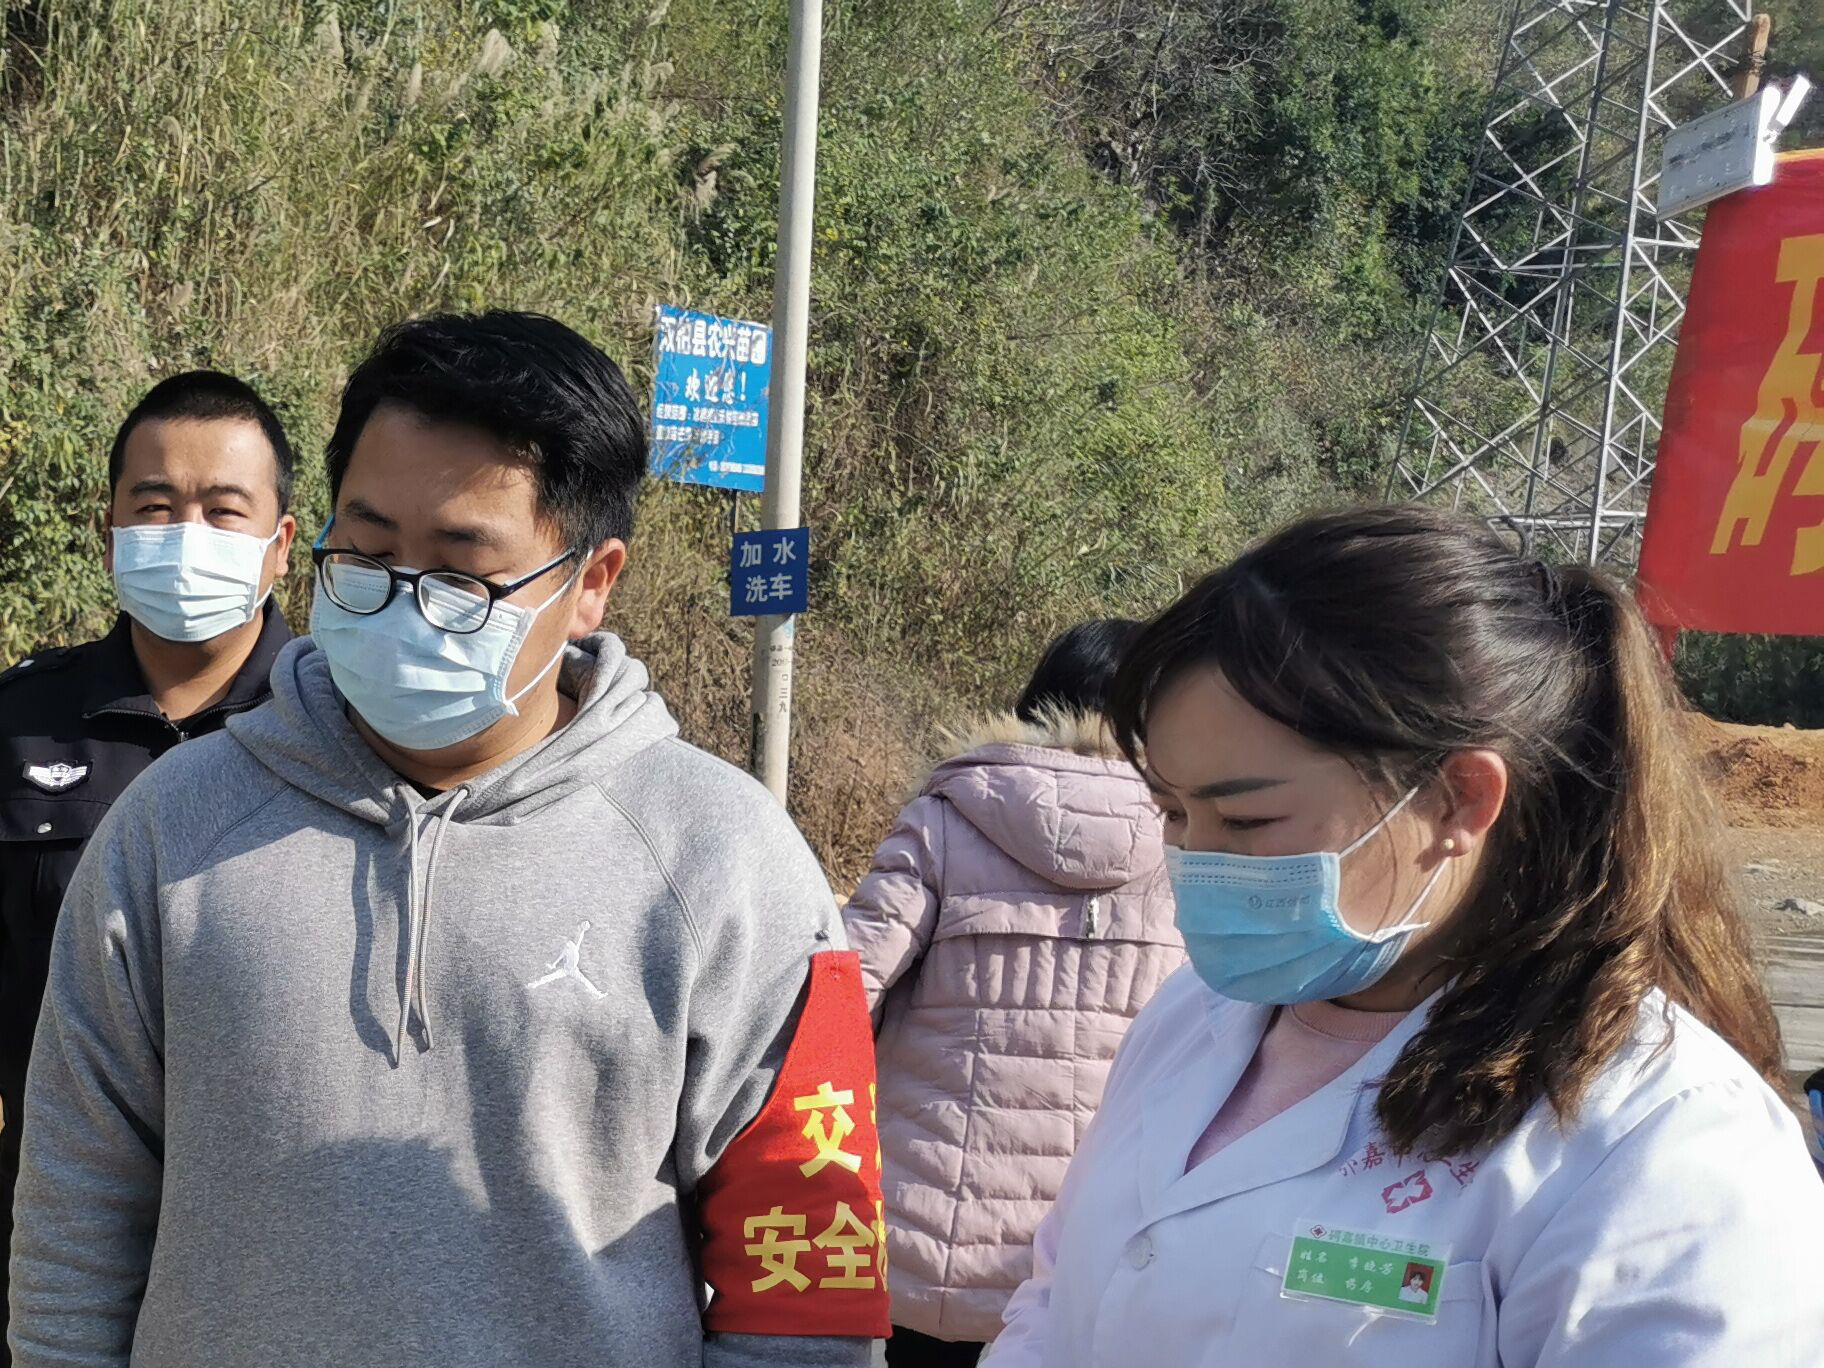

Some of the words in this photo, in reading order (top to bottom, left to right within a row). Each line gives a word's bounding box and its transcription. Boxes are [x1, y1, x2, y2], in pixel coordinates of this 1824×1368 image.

[740, 537, 796, 567] 加水
[745, 573, 793, 602] 洗车
[793, 1081, 881, 1178] 交
[743, 1200, 887, 1293] 安全
